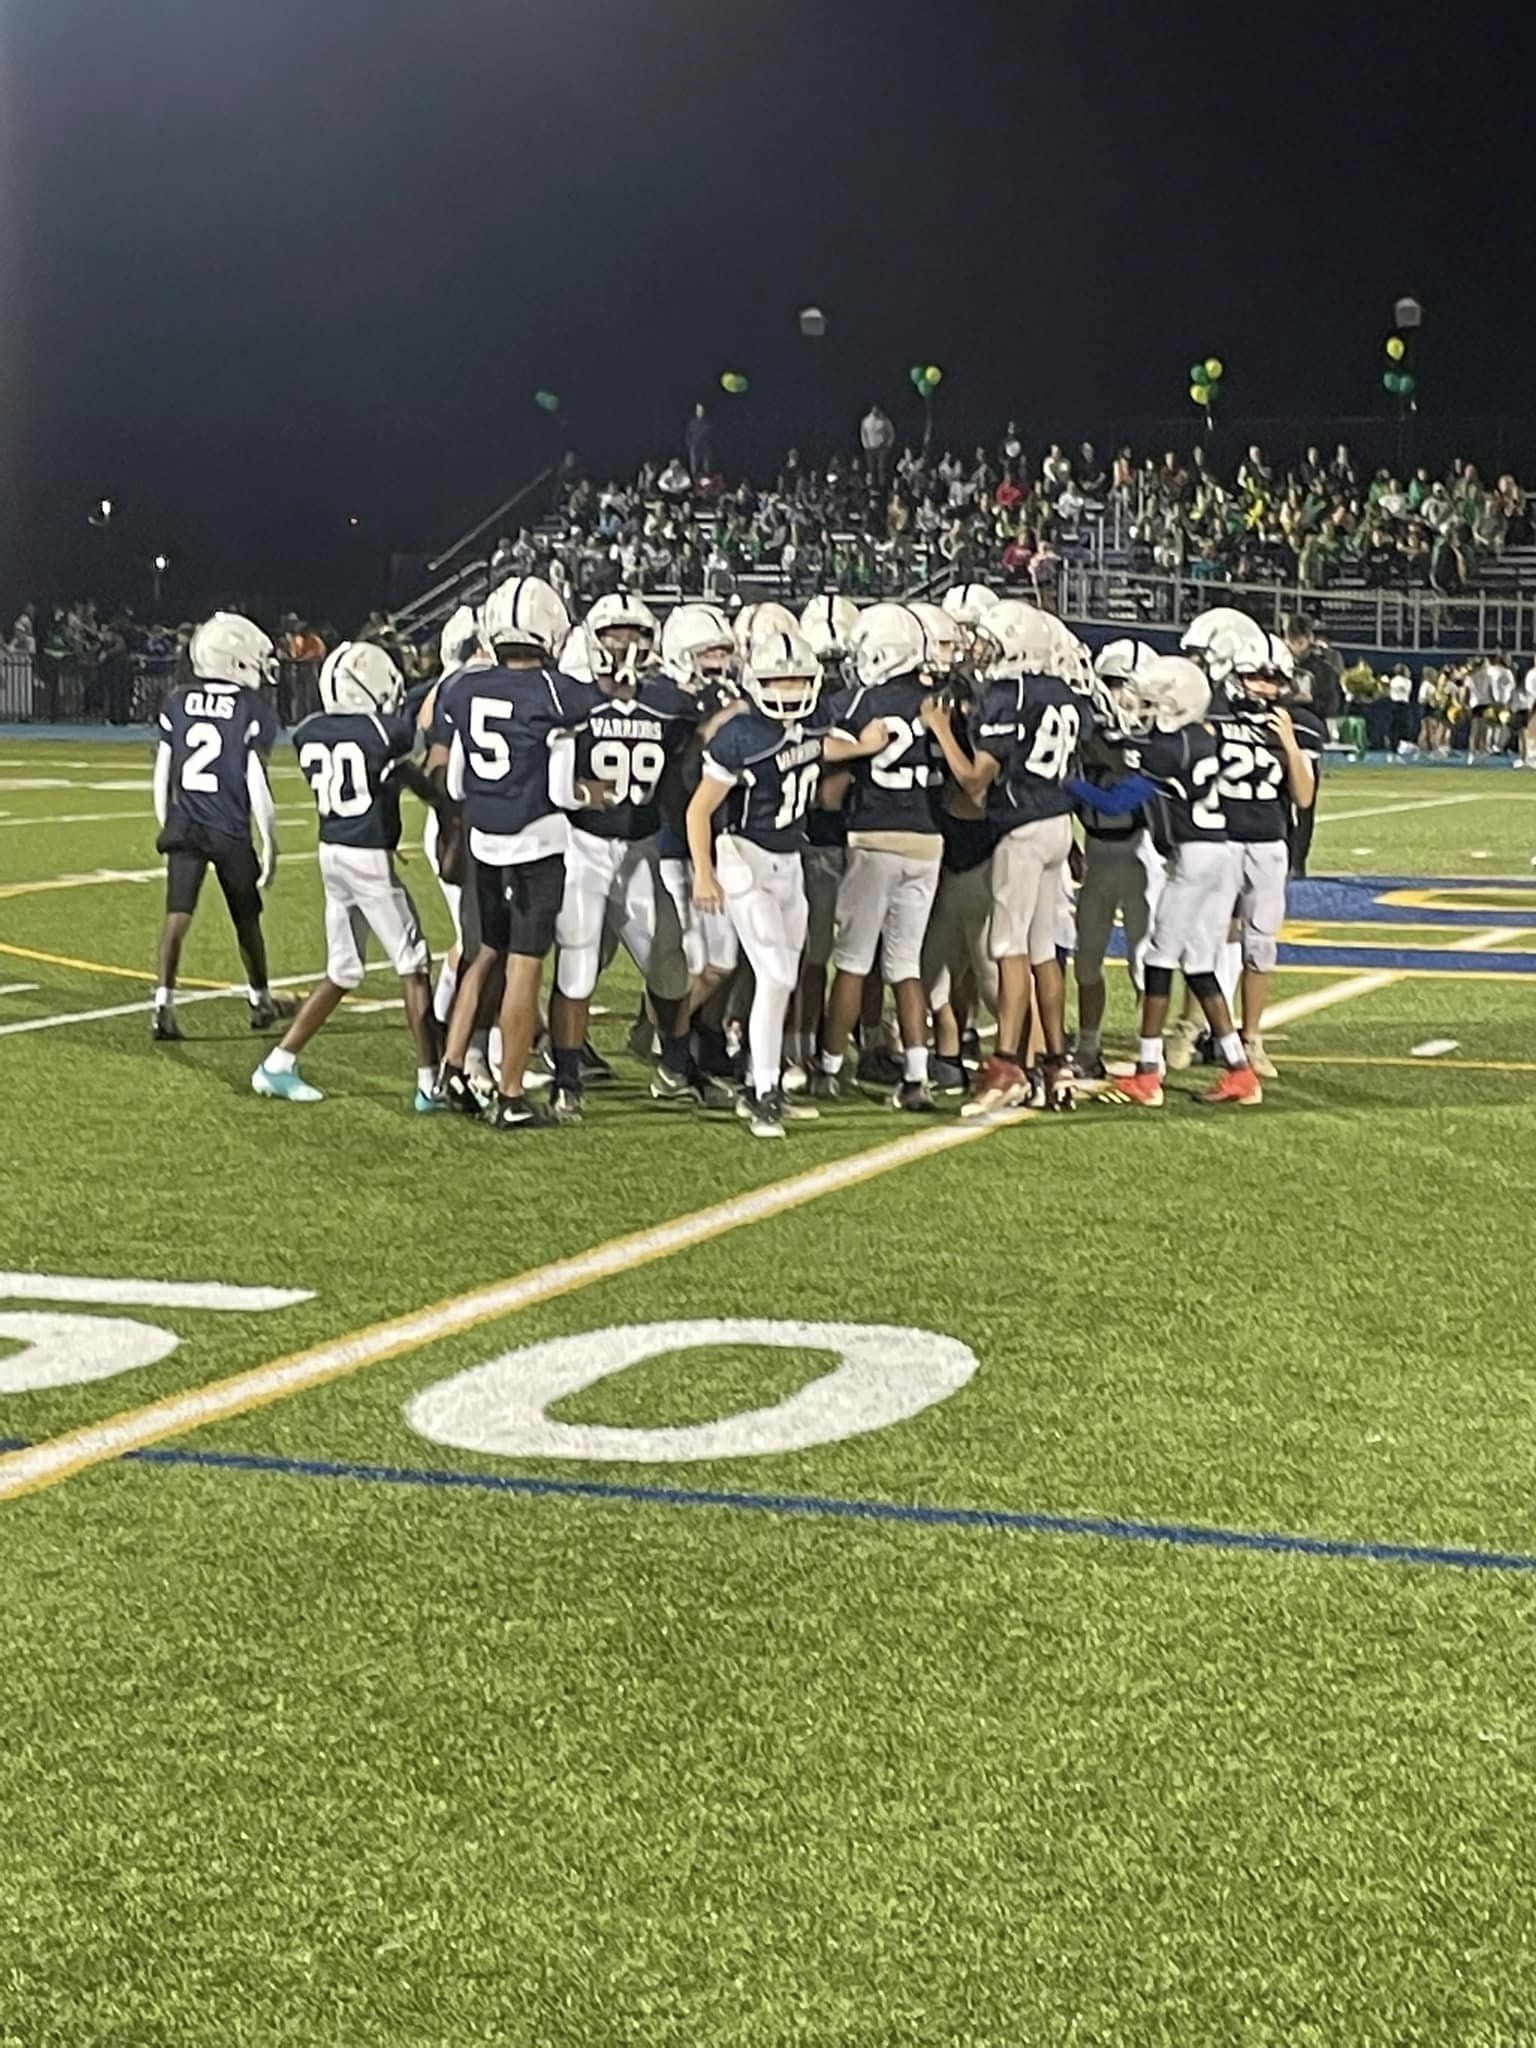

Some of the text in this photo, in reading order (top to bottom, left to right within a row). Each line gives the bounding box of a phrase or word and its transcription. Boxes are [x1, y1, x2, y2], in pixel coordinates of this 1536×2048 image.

[182, 723, 222, 793] 2
[469, 696, 514, 780] 5
[1217, 742, 1283, 800] 27
[300, 742, 373, 817] 30
[591, 741, 665, 805] 99
[775, 763, 820, 829] 10
